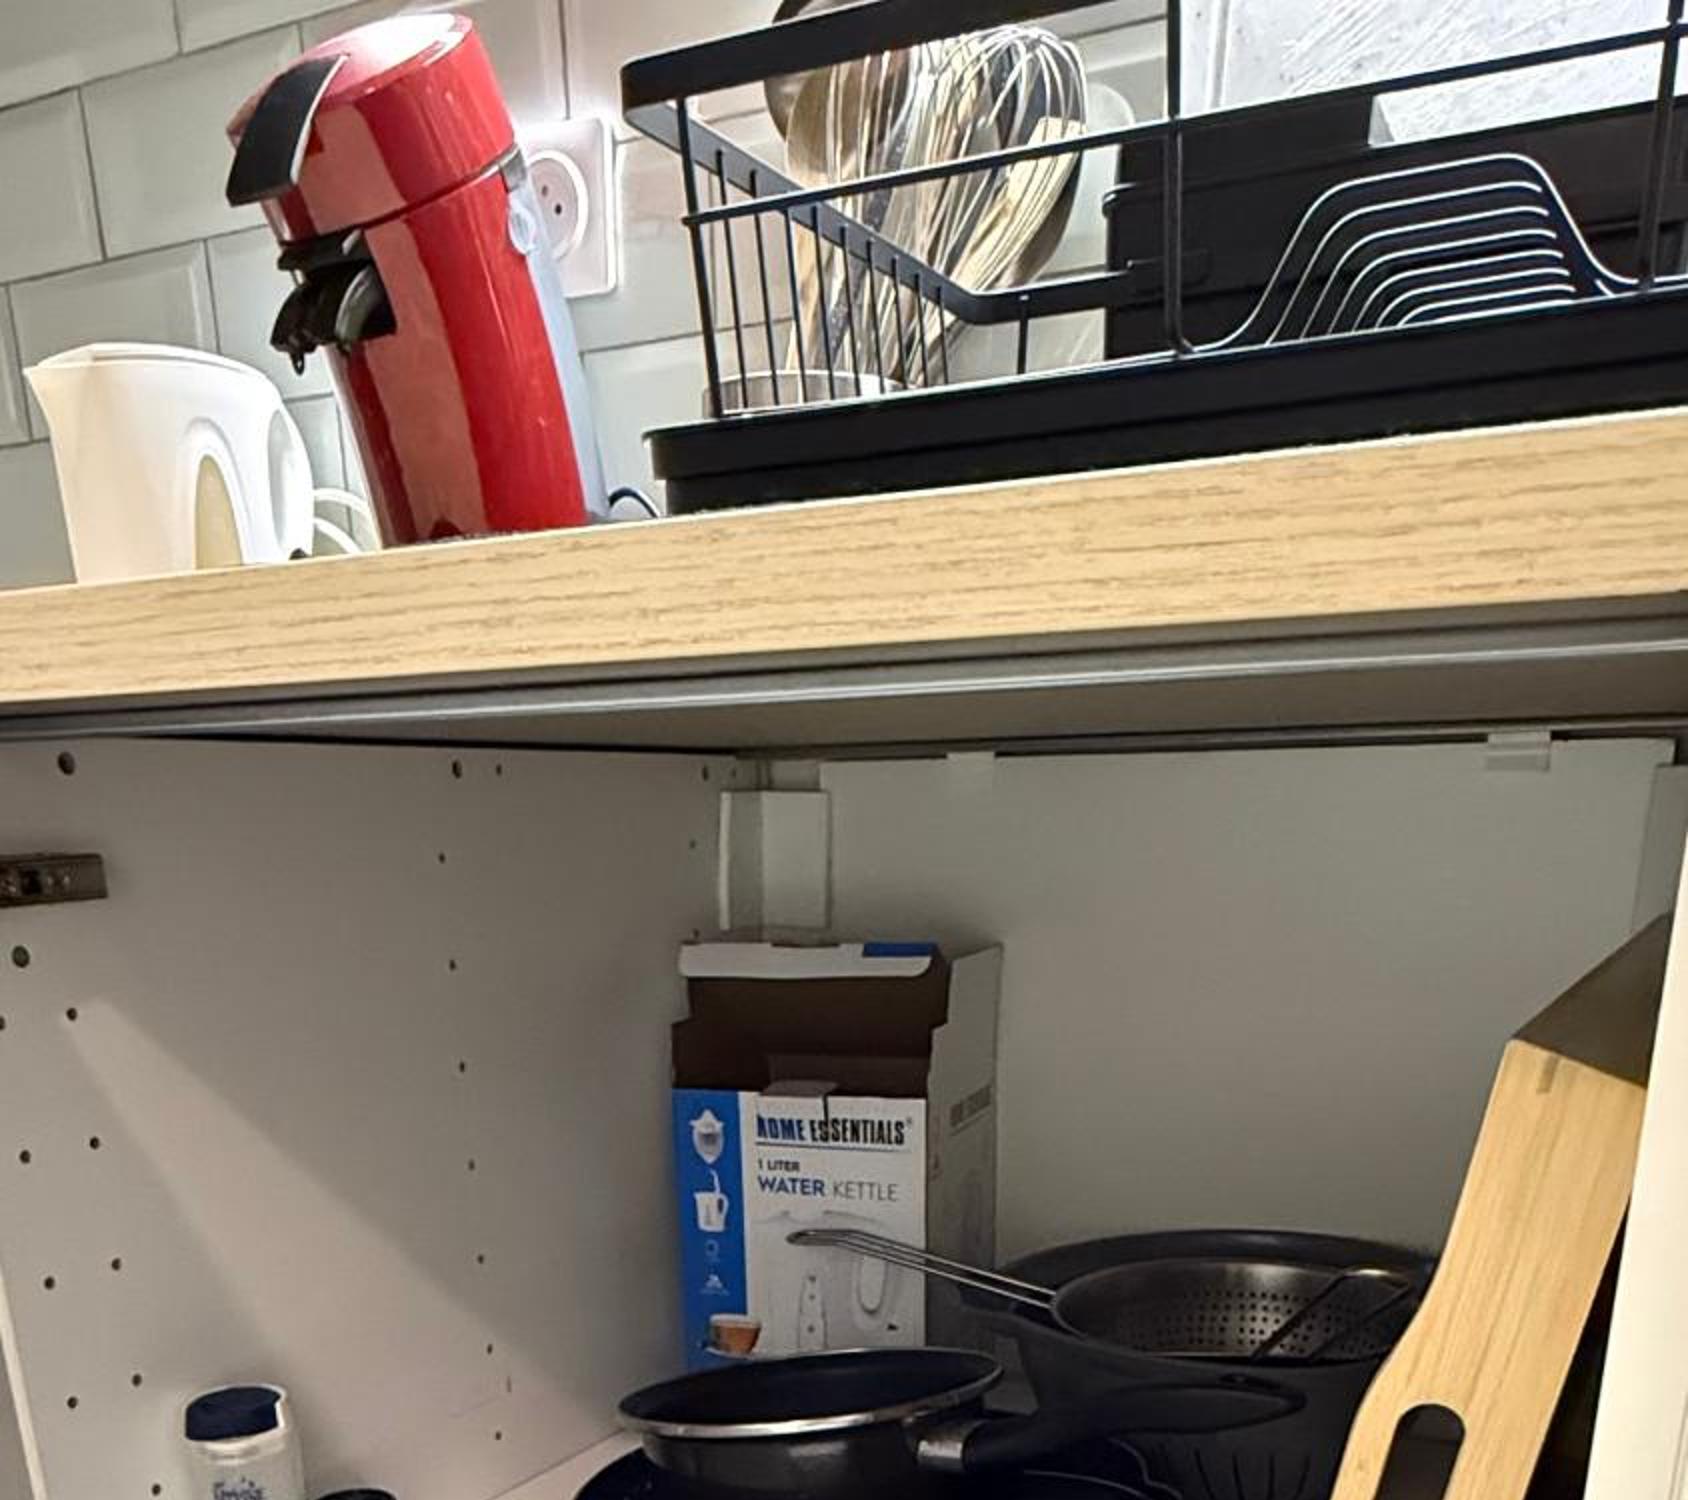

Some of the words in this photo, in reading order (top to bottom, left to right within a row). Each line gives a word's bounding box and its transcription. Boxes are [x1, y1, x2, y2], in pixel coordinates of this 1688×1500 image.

[757, 1114, 806, 1141] HOME
[809, 1117, 905, 1145] ESSENTIALS
[757, 1158, 764, 1170] 1
[767, 1159, 800, 1172] LITER
[757, 1176, 826, 1197] WATER
[832, 1180, 899, 1201] KETTLE
